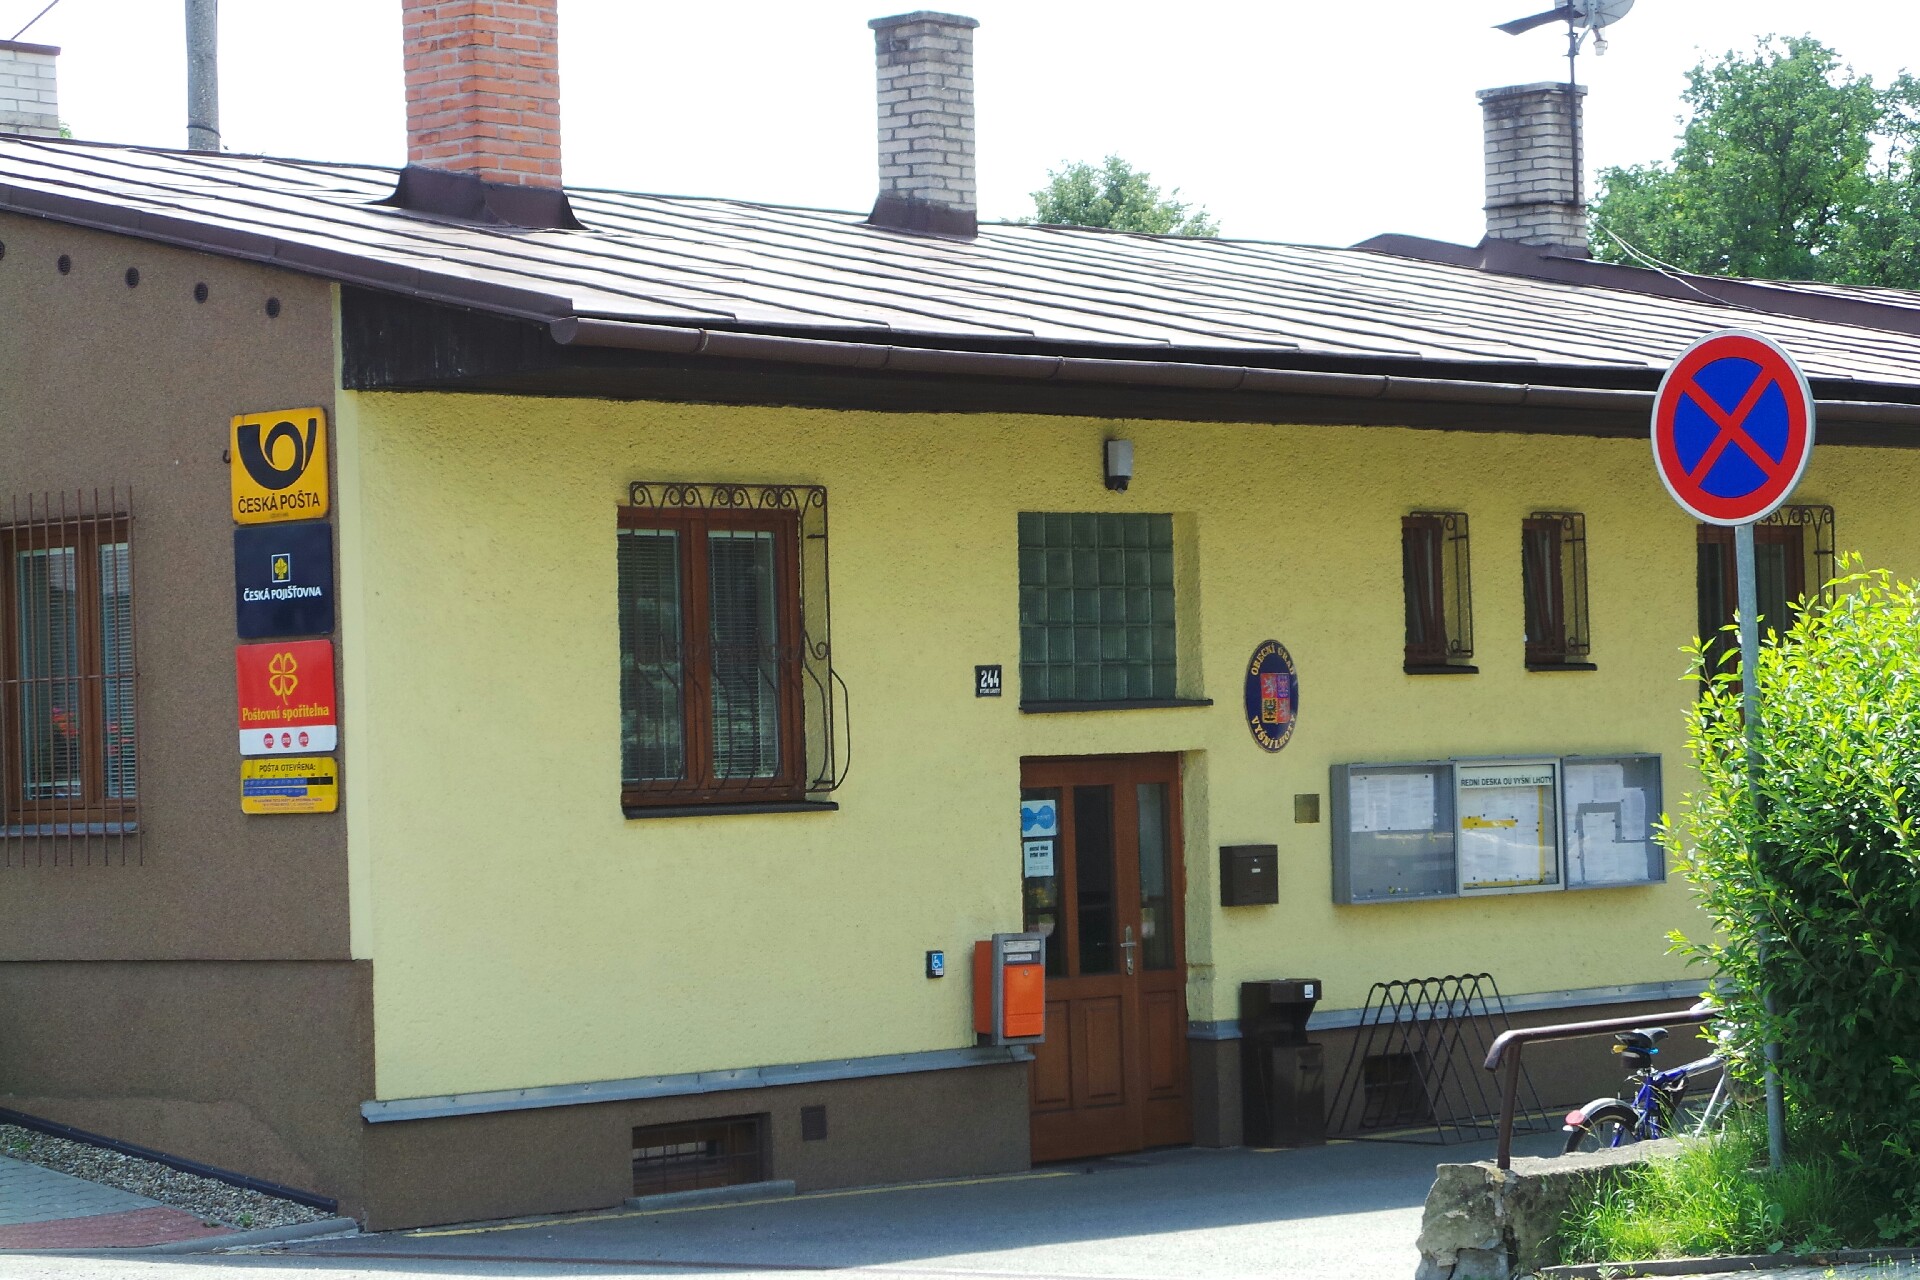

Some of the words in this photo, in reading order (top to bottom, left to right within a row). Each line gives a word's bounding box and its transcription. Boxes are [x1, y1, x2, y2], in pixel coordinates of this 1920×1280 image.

[238, 493, 278, 514] ČESKÁ
[280, 490, 320, 510] POŠTA
[243, 587, 270, 602] ČESKÁ
[271, 585, 322, 601] POJIŠŤOVNA
[1250, 642, 1276, 676] OBECNÍ
[980, 670, 999, 688] 244
[242, 705, 280, 721] Poštovní
[282, 703, 329, 721] spořitelna
[259, 763, 279, 773] POŠTA
[1482, 778, 1502, 786] DESKA
[1513, 774, 1531, 784] VYŠNÍ
[1532, 776, 1553, 784] LHOTY
